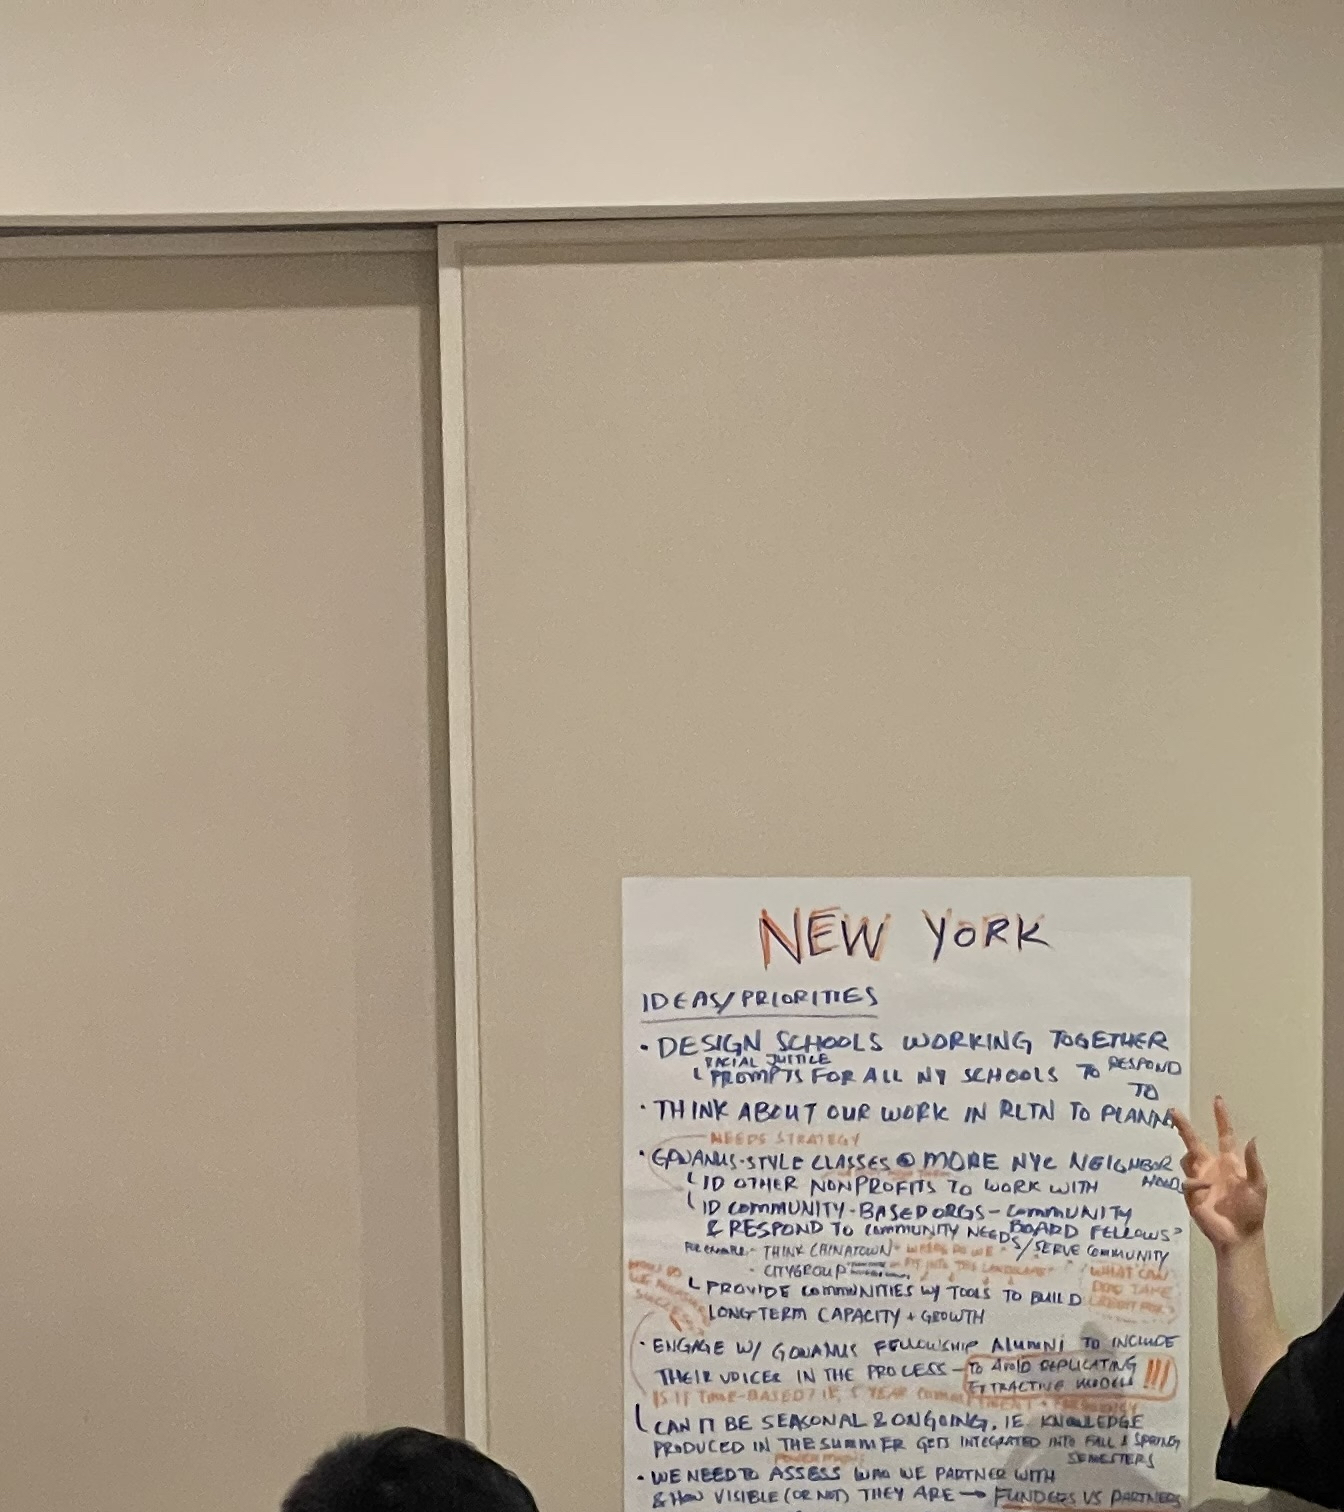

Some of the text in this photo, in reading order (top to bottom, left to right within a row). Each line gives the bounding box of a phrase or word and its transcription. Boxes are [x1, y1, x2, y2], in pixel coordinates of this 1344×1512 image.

[759, 906, 1055, 971] NEW YORK
[657, 1029, 1169, 1059] DESIGN SCHOOLS WORKING TOGETHER
[710, 1056, 1182, 1088] PROMPTS FOR ALL NY SCHOOLS TO RESPOND
[1127, 1082, 1159, 1101] TO
[653, 1099, 1091, 1125] THINK ABOUT OUR WORK IN RLTN TO
[811, 1154, 888, 1171] CLASSES
[923, 1151, 1000, 1172] MORE
[703, 1175, 725, 1192] ID
[734, 1175, 797, 1192] OTHER
[950, 1180, 972, 1196] TO
[984, 1178, 1042, 1193] WORK
[1049, 1181, 1098, 1194] WITH
[703, 1200, 721, 1216] ID
[729, 1219, 824, 1238] RESPOND
[830, 1220, 854, 1237] TO
[967, 1224, 1020, 1249] NEEDS
[1009, 1220, 1079, 1240] BOARD
[764, 1245, 804, 1260] THINK
[706, 1280, 791, 1299] PROVIDE
[946, 1285, 990, 1299] TOOLS
[1003, 1290, 1022, 1301] TO
[1030, 1290, 1082, 1306] BUILD
[818, 1307, 901, 1329] CAPACITY
[921, 1309, 984, 1324] GROWTH
[653, 1338, 725, 1353] ENGAGE
[736, 1342, 761, 1360] W/
[1081, 1337, 1100, 1348] TO
[1112, 1334, 1180, 1348] INCLUDE
[798, 1369, 815, 1383] IN
[824, 1367, 854, 1382] THE
[868, 1362, 946, 1379] PROCESS
[654, 1418, 690, 1436] CAN
[725, 1415, 753, 1432] BE
[762, 1412, 868, 1429] SEASONAL
[654, 1440, 745, 1458] PRODUCED
[754, 1437, 771, 1452] IN
[778, 1437, 816, 1451] THE
[820, 1437, 907, 1451] SUMMER
[651, 1467, 681, 1485] WE
[769, 1465, 841, 1482] ASSESS
[900, 1466, 926, 1480] WE
[935, 1466, 1006, 1483] PARTNER
[1014, 1470, 1056, 1483] WITH
[714, 1489, 778, 1504] VISIBLE
[858, 1486, 904, 1502] THEY
[913, 1486, 954, 1502] ARE
